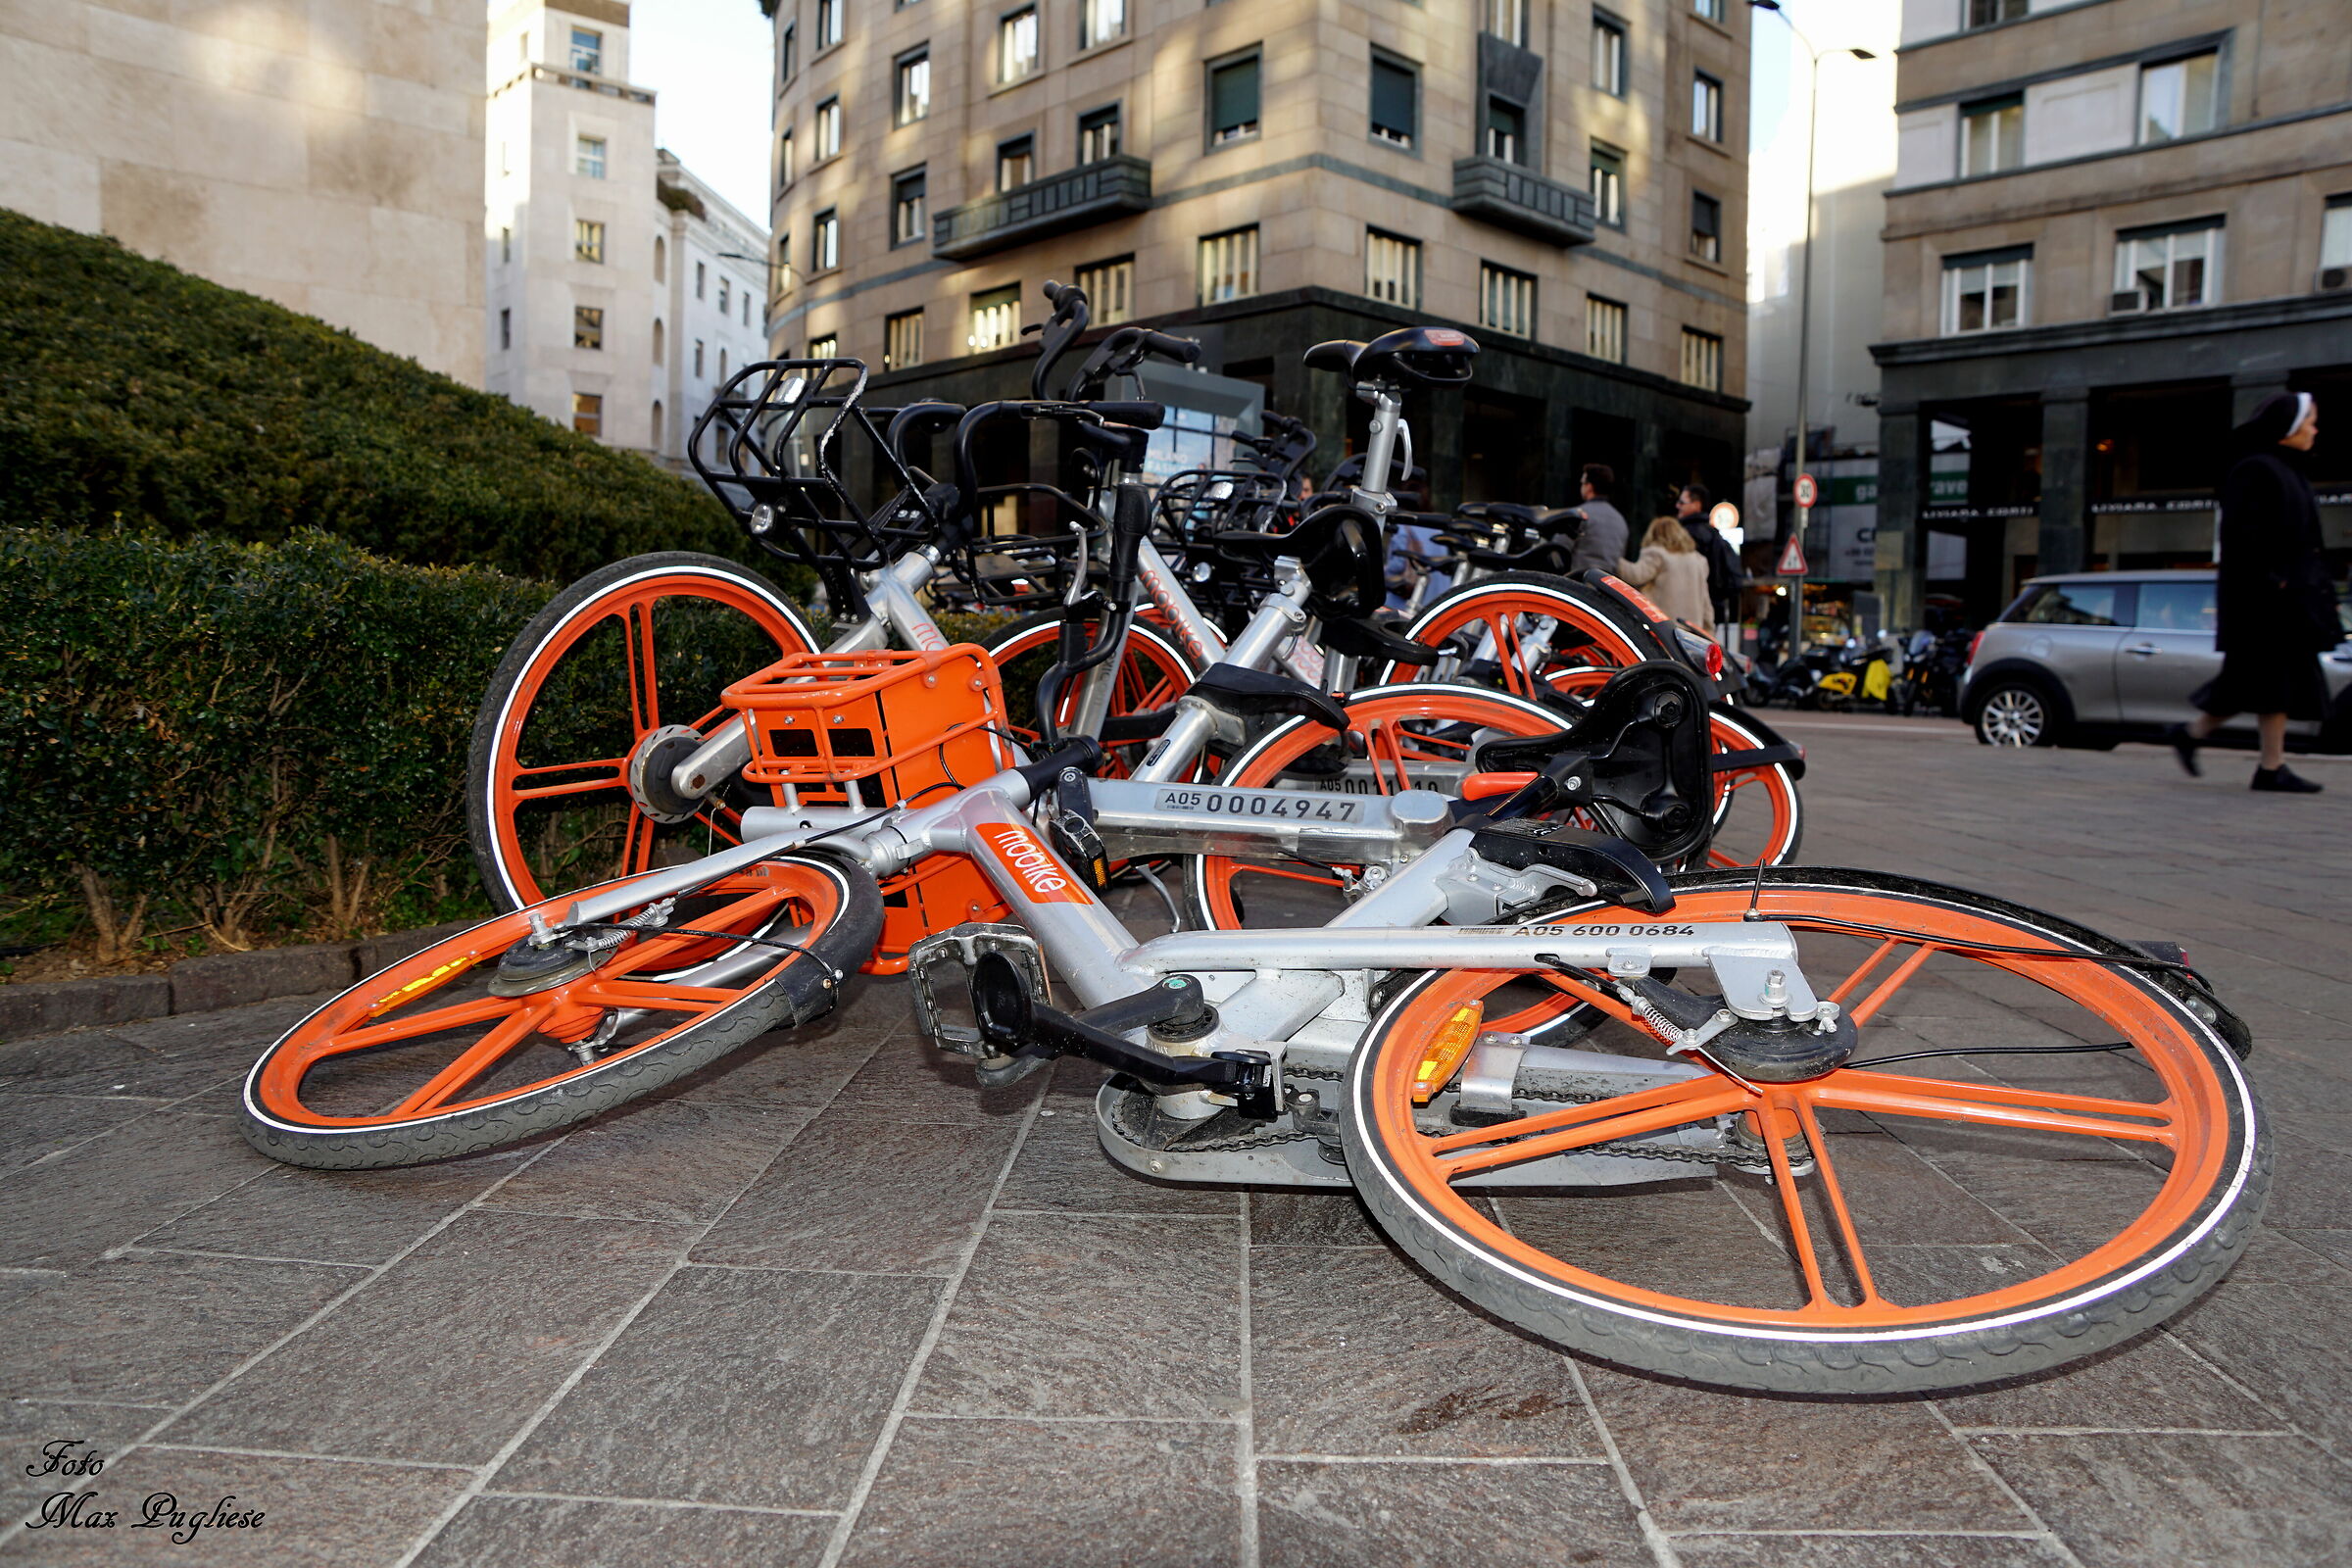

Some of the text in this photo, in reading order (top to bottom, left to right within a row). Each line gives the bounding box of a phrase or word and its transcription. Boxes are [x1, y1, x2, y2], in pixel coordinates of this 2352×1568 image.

[1141, 570, 1202, 659] mobike
[1319, 778, 1342, 792] A05
[1164, 792, 1356, 821] A05 0004947
[994, 830, 1066, 893] mobike
[1512, 925, 1694, 936] A05 600 0684
